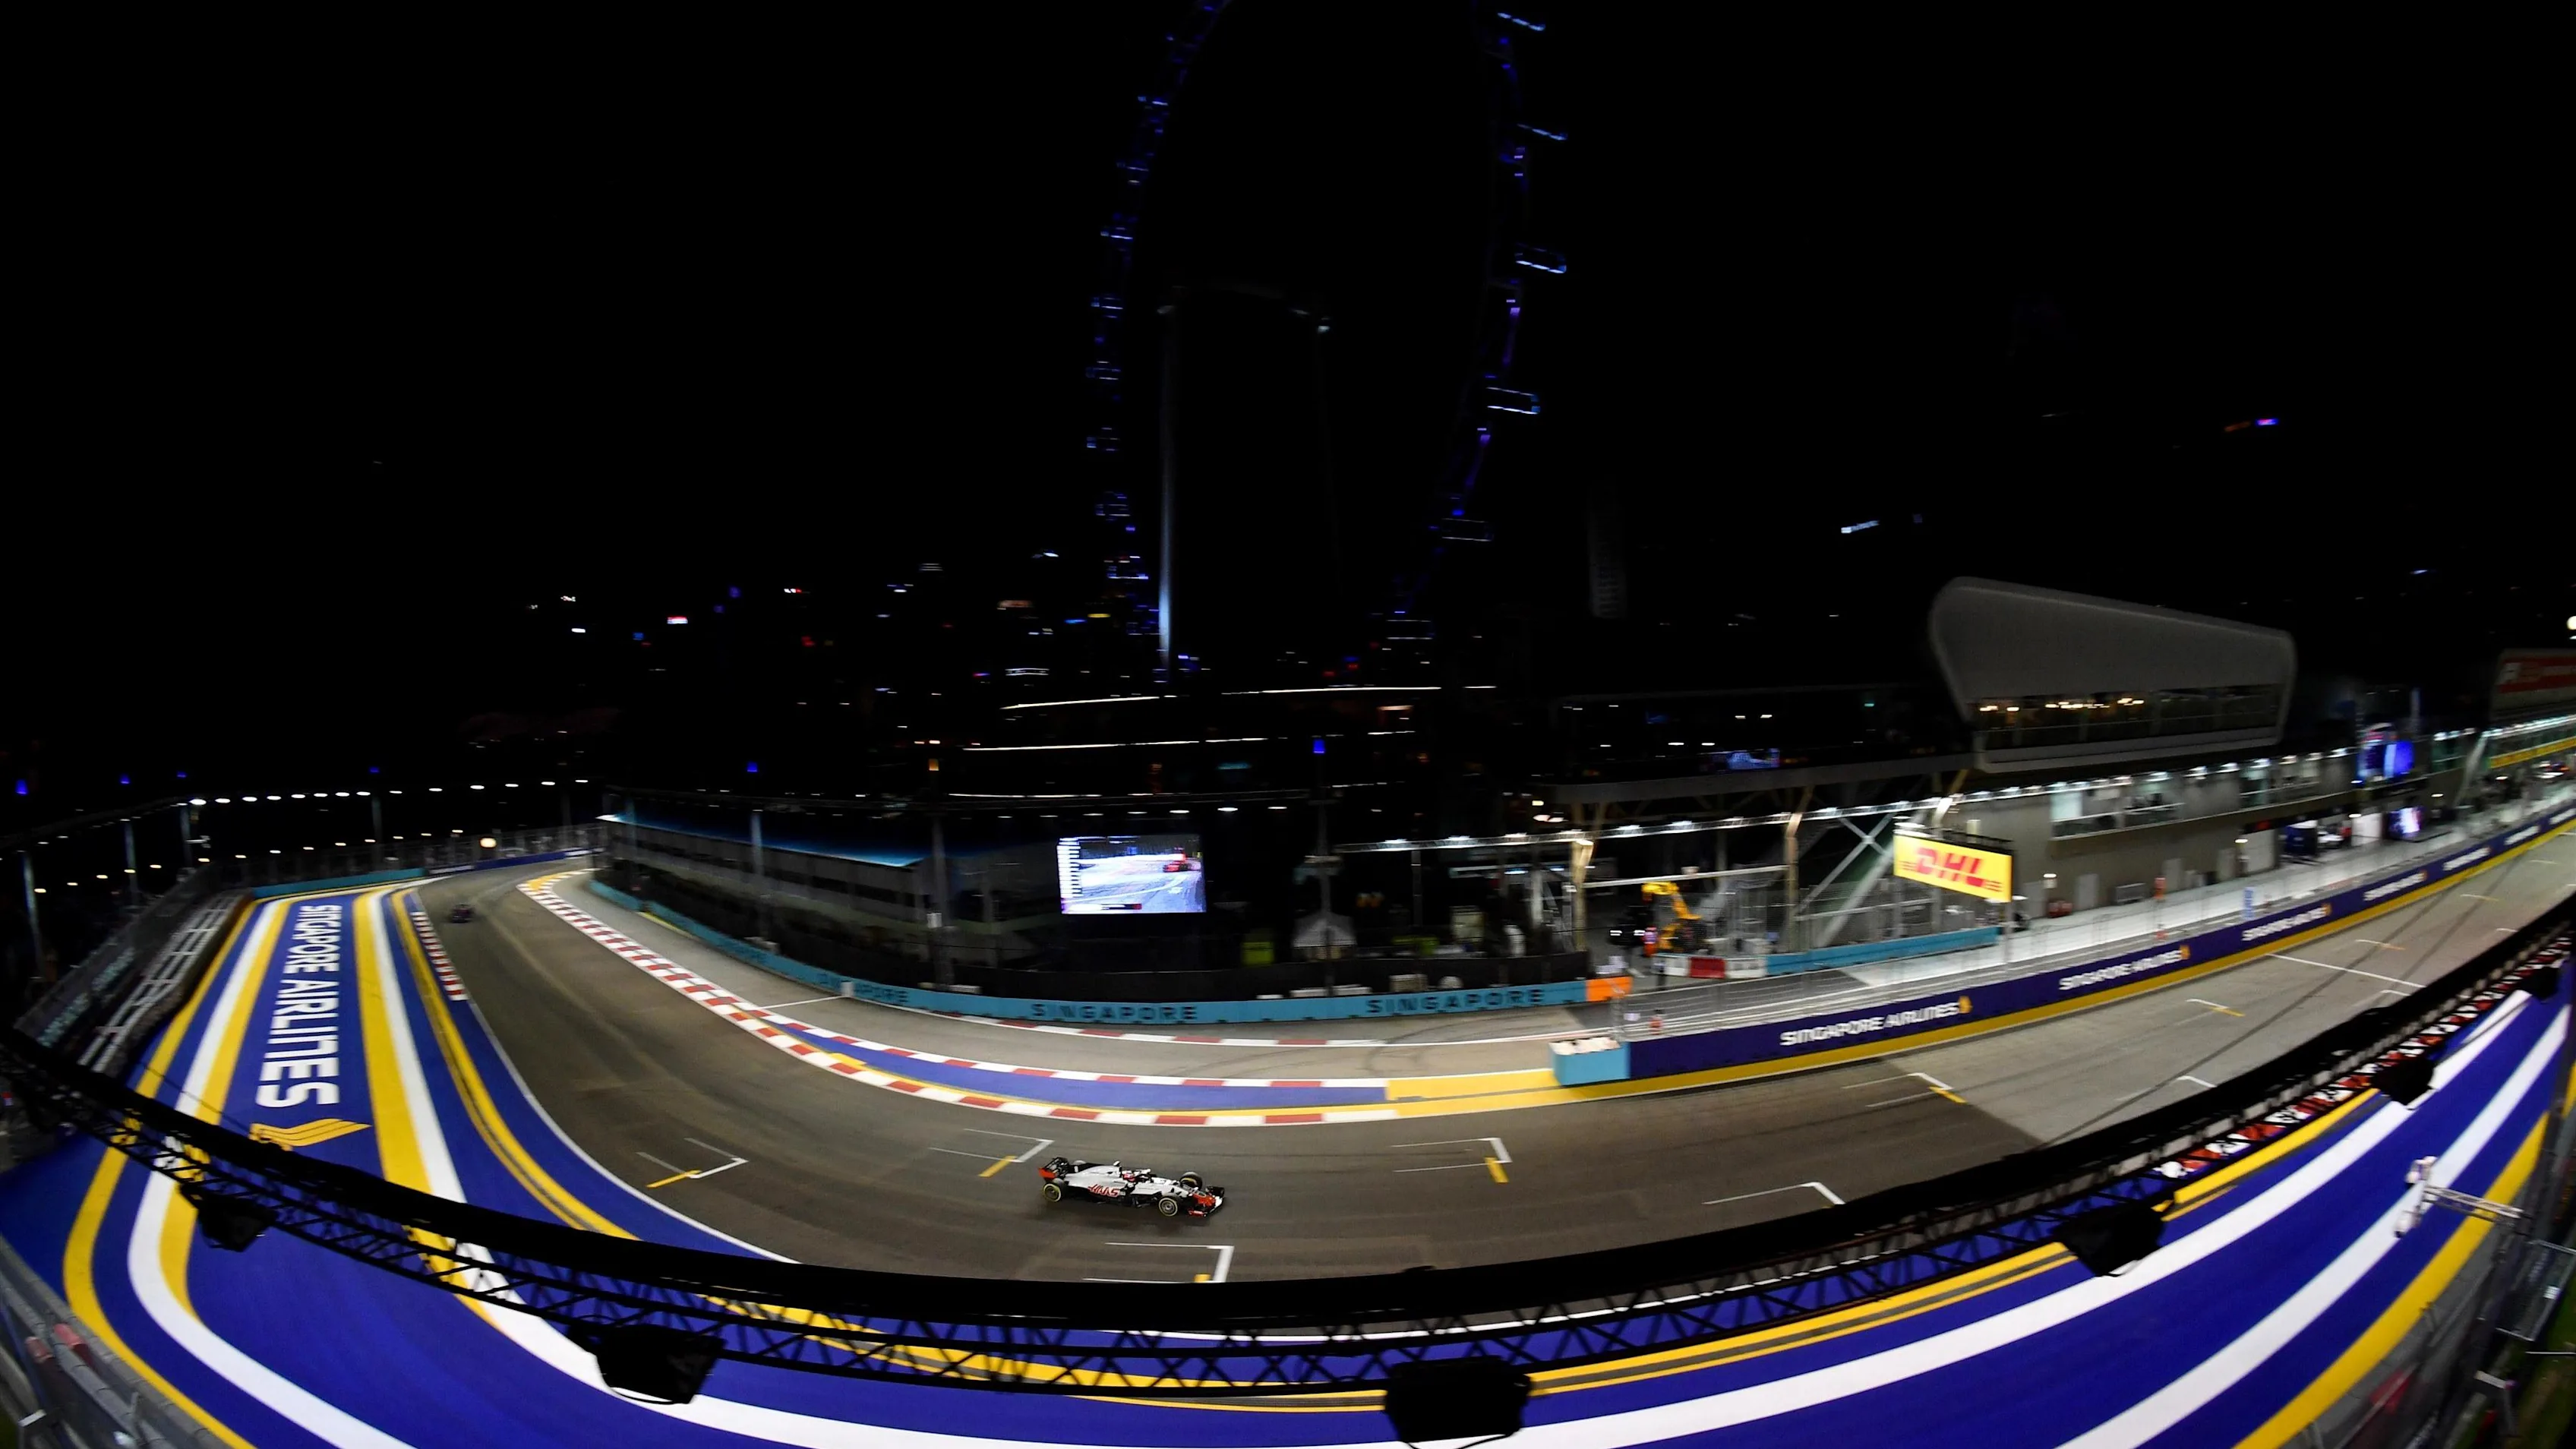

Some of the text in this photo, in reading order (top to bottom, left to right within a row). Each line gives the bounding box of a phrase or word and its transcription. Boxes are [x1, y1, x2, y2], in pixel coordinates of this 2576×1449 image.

[1916, 847, 1985, 887] DHL
[255, 904, 343, 1108] SINGAPORE AIRLINES
[1031, 1003, 1198, 1021] SINGAPORE
[1365, 989, 1545, 1014] SINGAPORE
[1779, 1016, 1885, 1046] SINGAPORE
